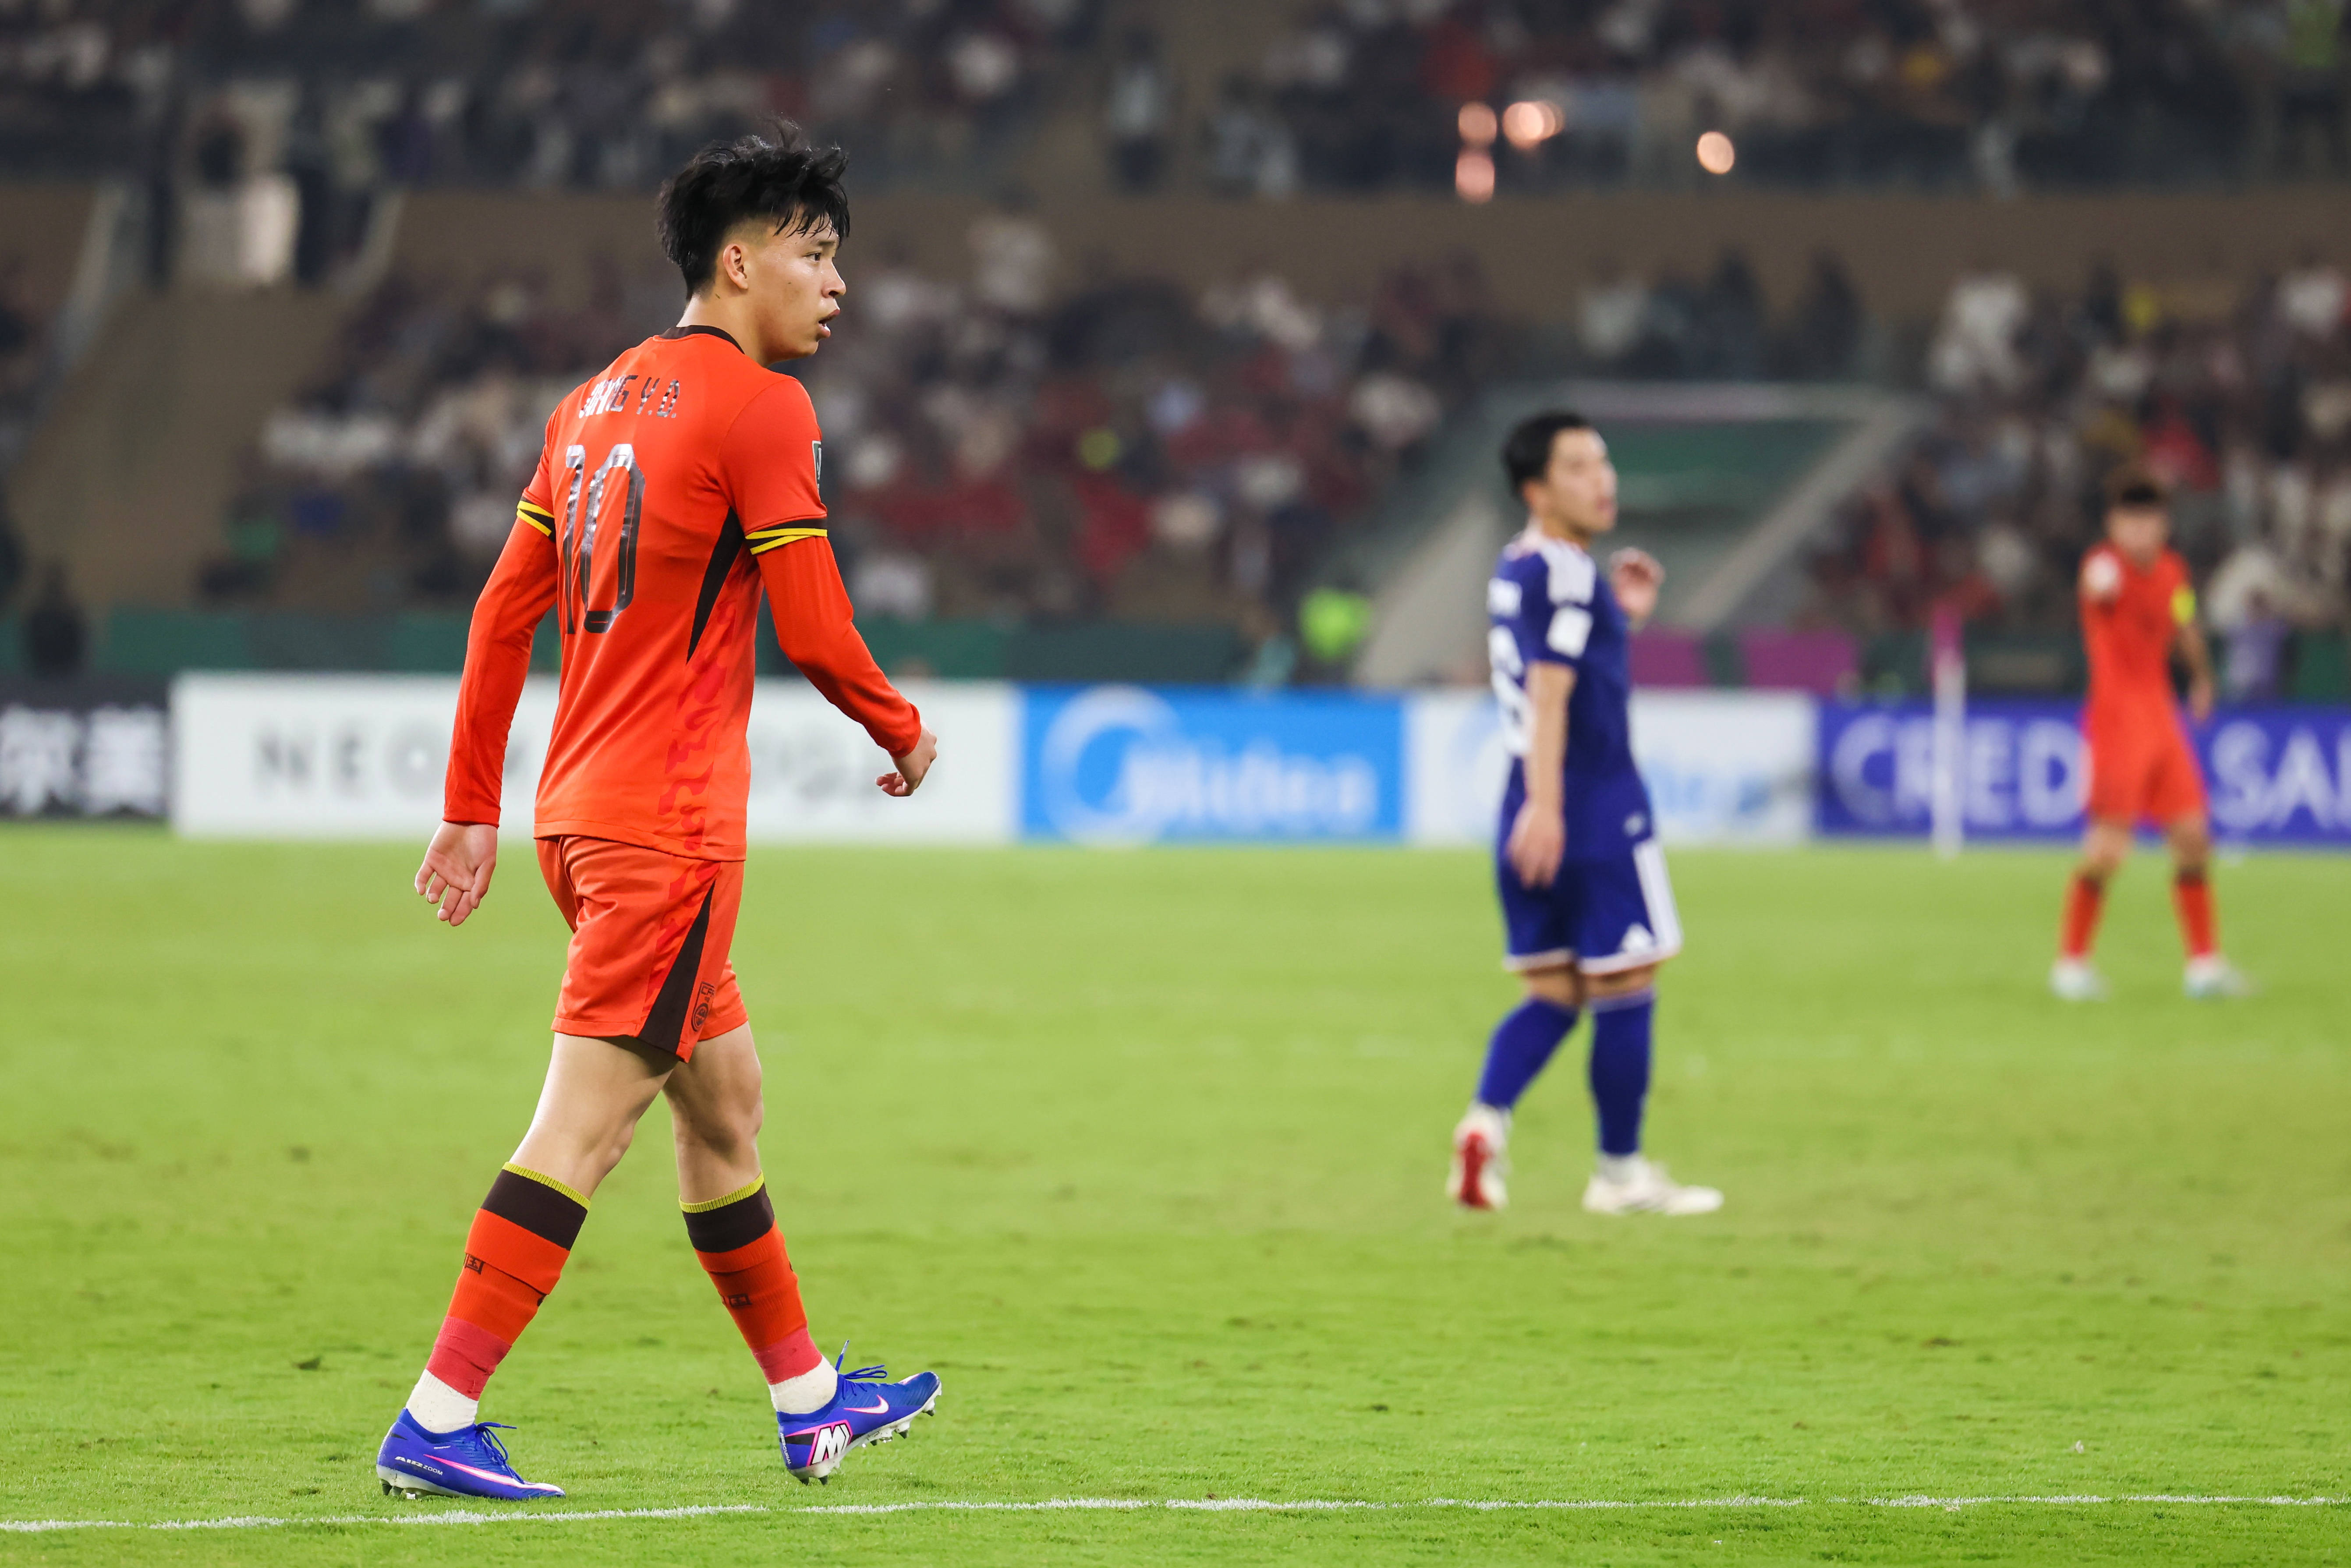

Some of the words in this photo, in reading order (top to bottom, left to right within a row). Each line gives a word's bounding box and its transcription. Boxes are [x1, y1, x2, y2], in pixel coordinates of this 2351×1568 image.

[563, 443, 645, 634] 10
[1834, 715, 2095, 826] CRED
[394, 1456, 423, 1468] AIR
[423, 1465, 443, 1476] ZOOM
[779, 1432, 792, 1465] MERCURIAL
